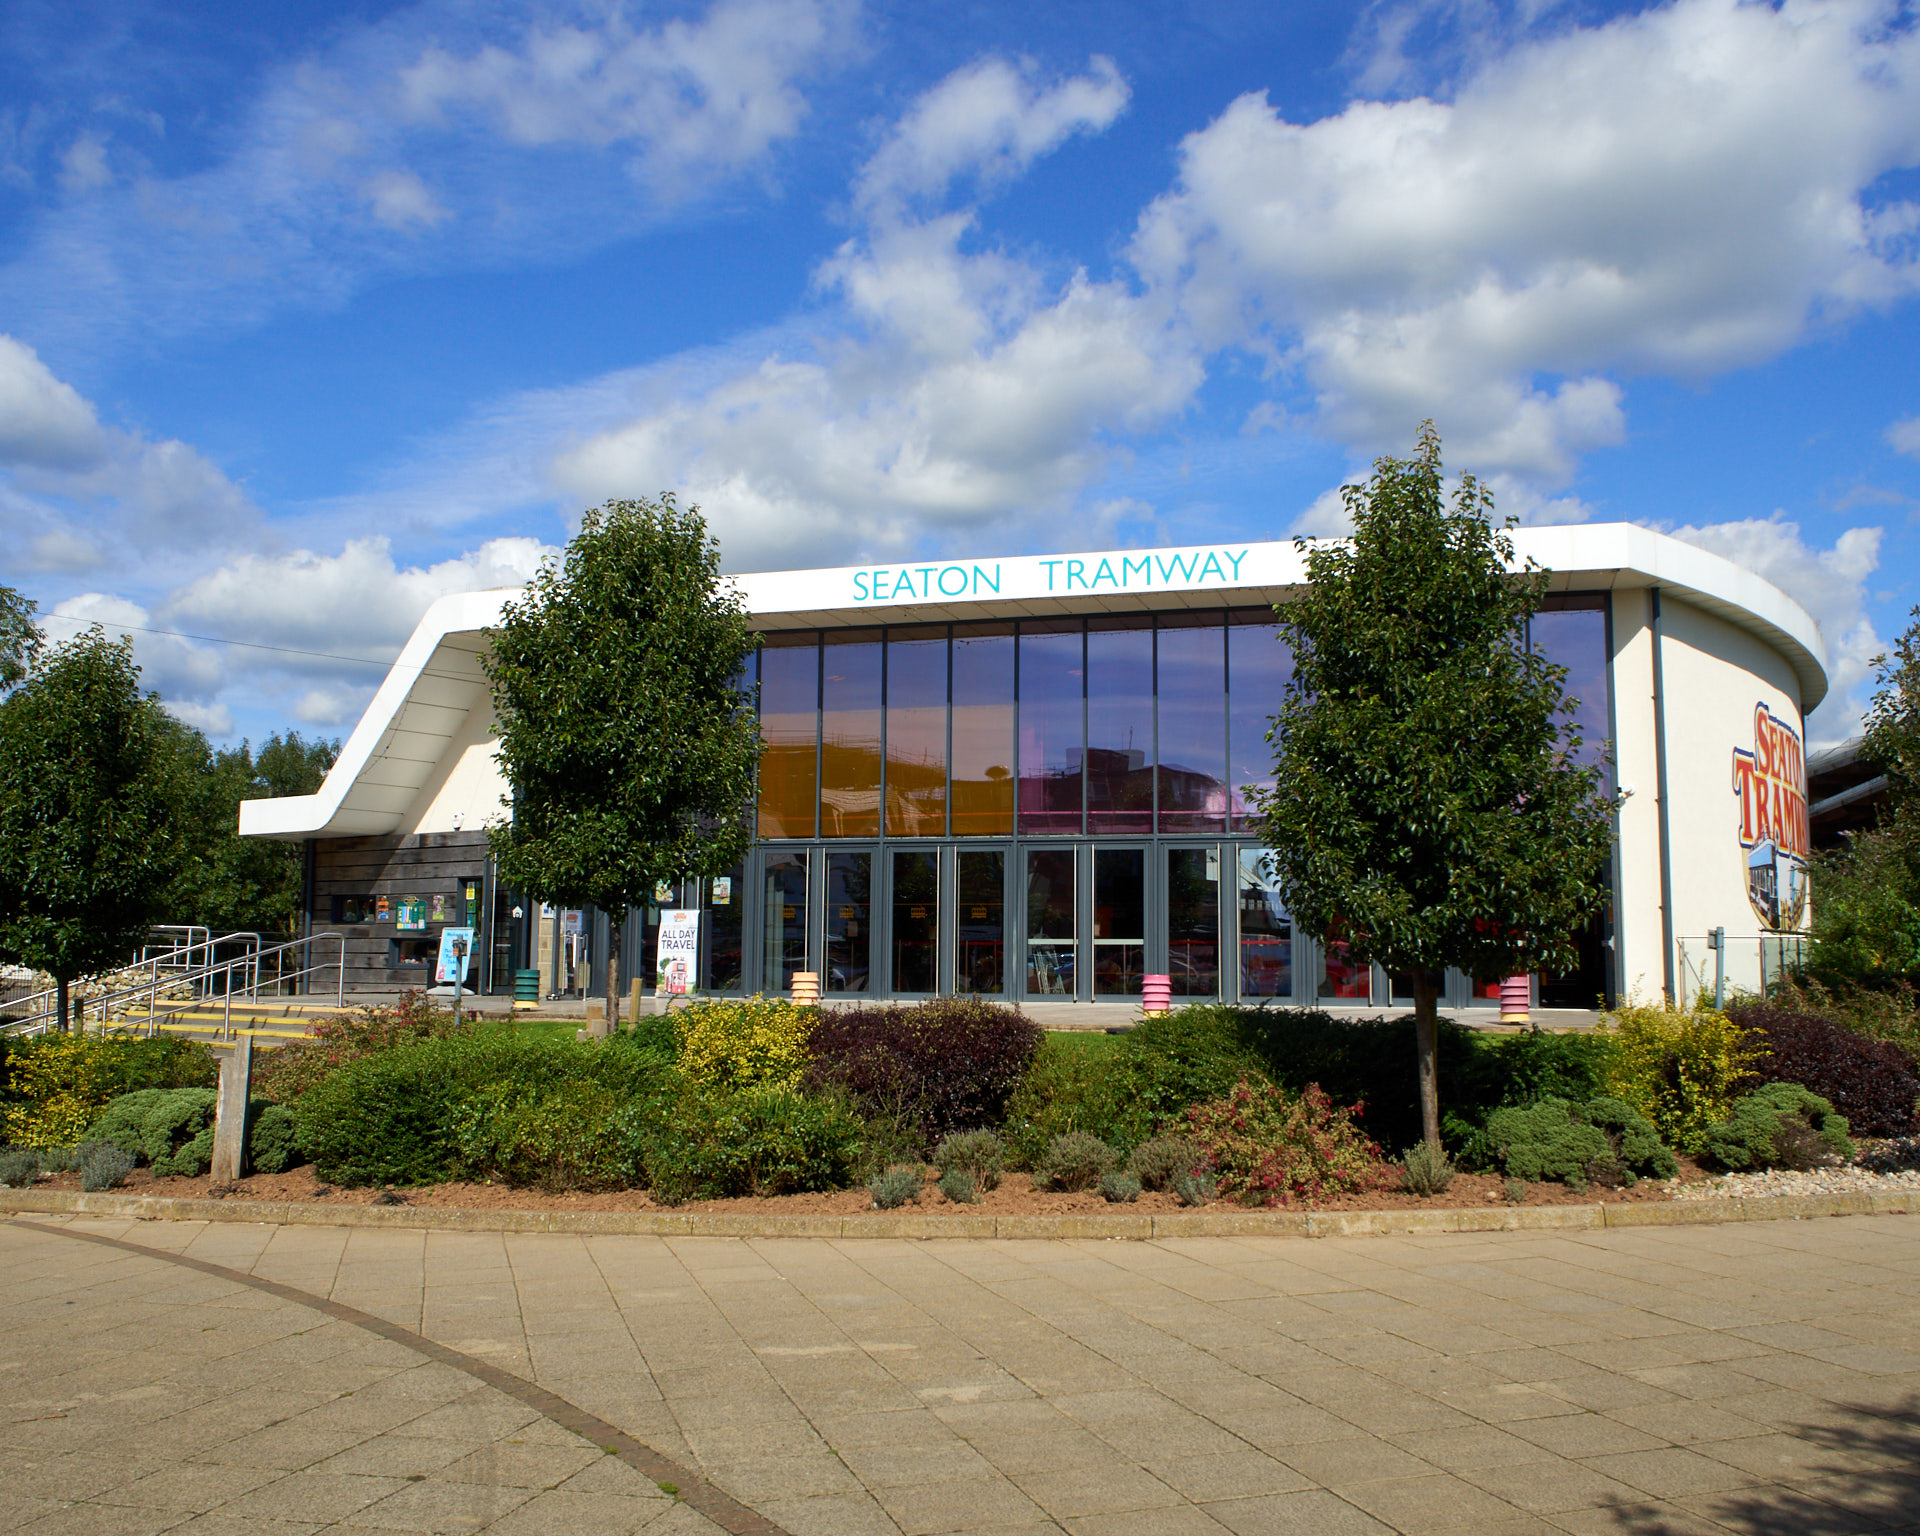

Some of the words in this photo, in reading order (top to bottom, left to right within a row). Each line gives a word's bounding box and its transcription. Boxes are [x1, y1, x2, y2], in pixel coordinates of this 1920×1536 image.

[853, 563, 1001, 601] SEATON
[1039, 550, 1249, 591] TRAMWAY
[1756, 709, 1802, 793] SEATON
[1734, 757, 1809, 859] TRAMWA
[661, 940, 695, 949] TRAVEL
[662, 930, 677, 939] ALL
[679, 930, 696, 939] DAY
